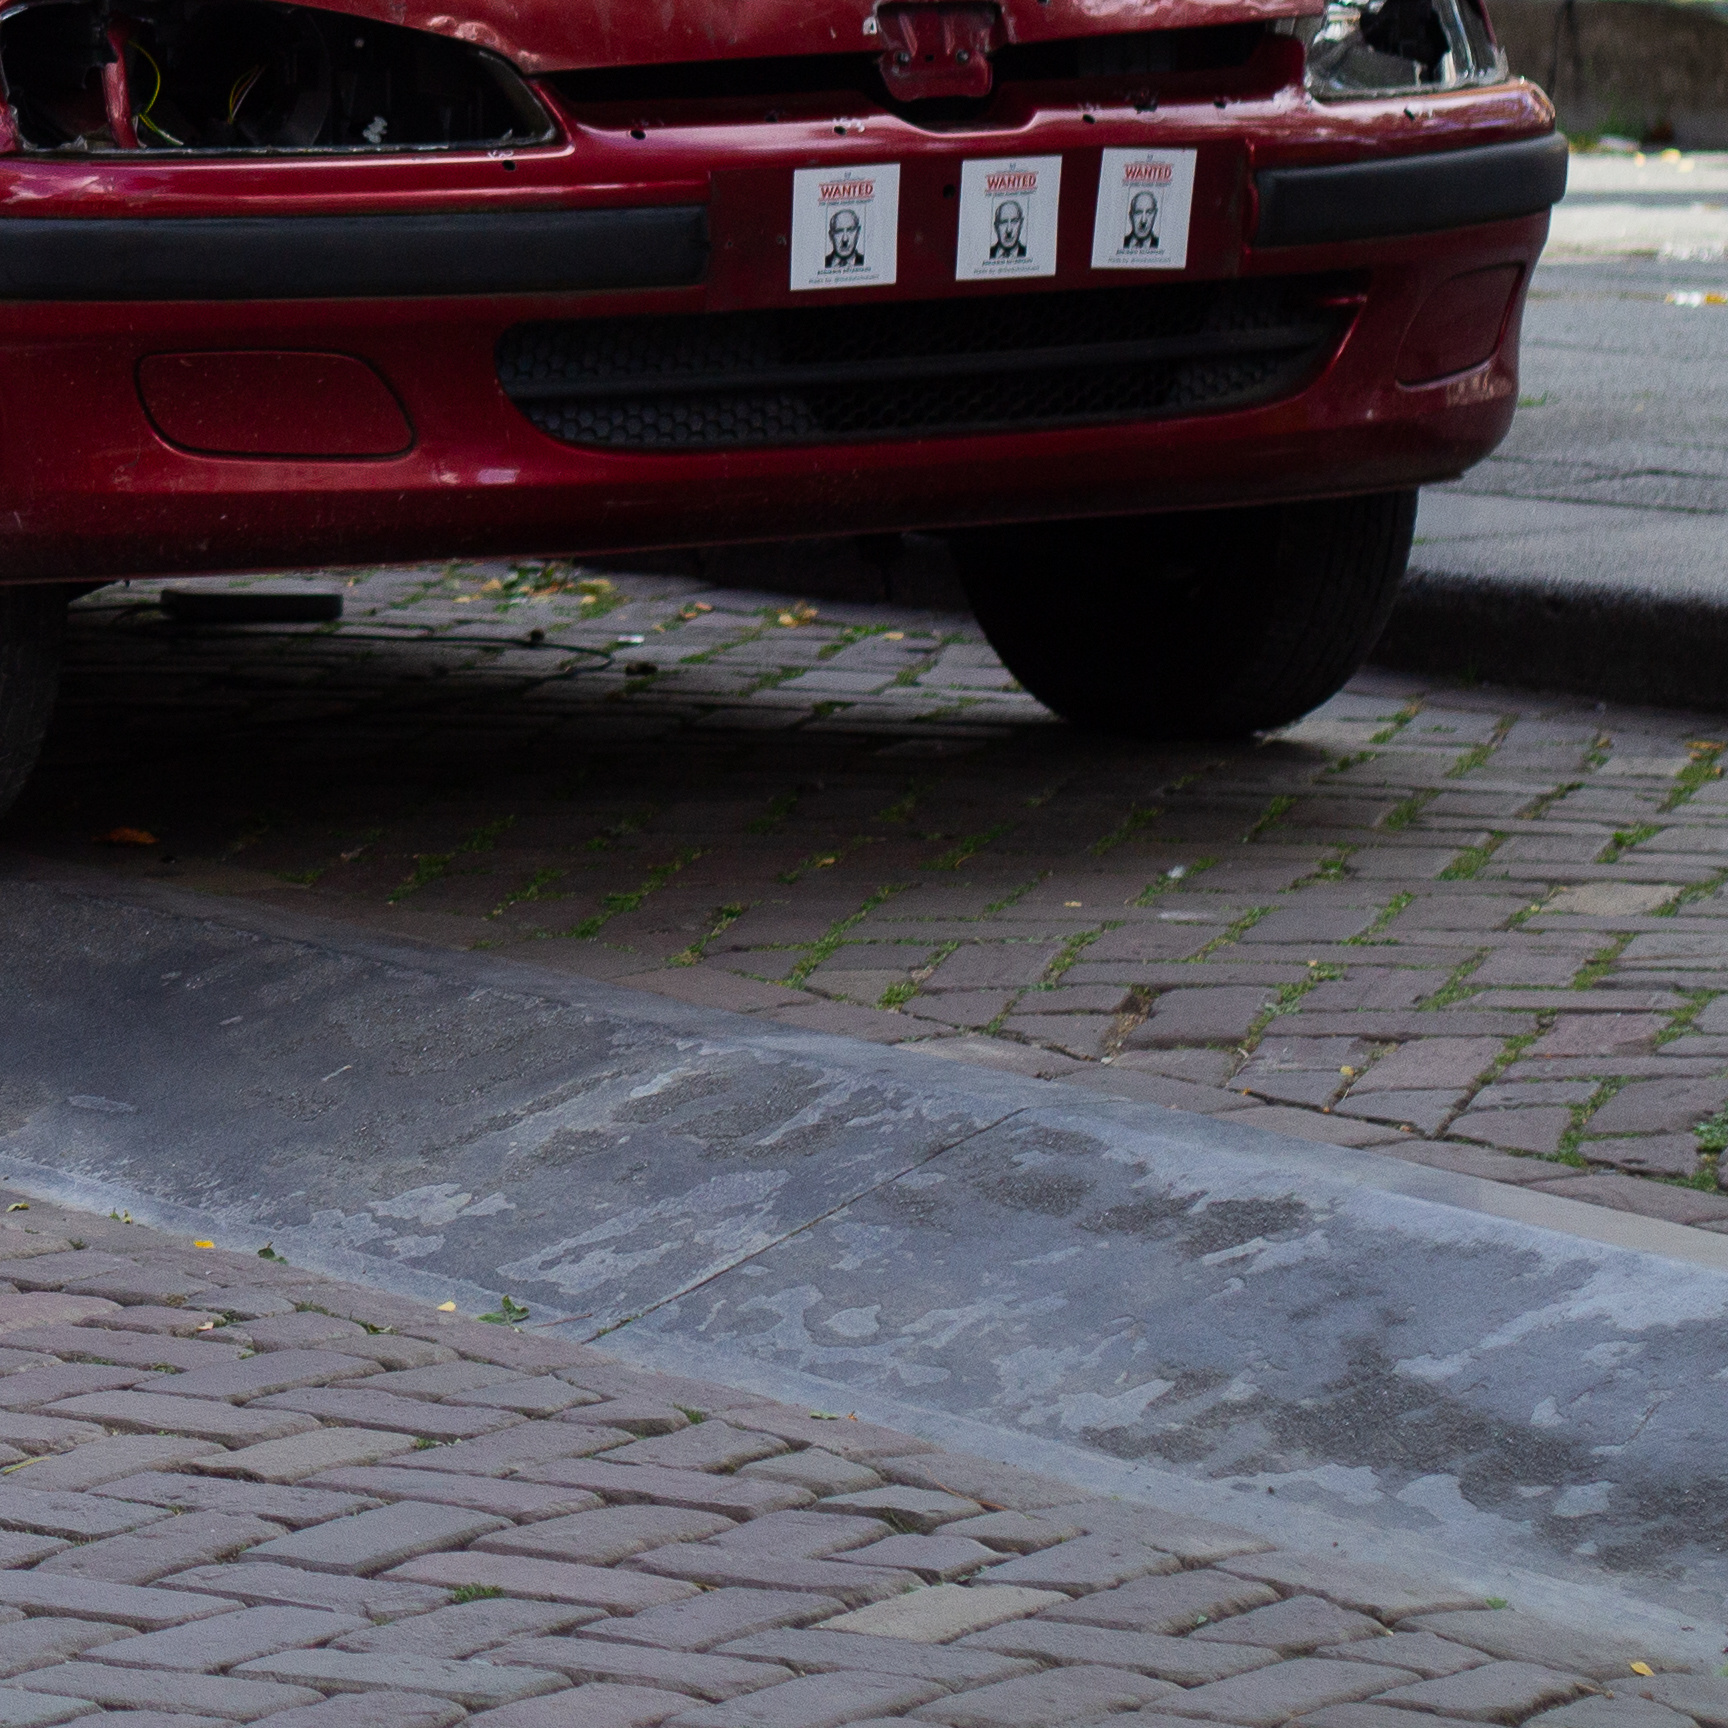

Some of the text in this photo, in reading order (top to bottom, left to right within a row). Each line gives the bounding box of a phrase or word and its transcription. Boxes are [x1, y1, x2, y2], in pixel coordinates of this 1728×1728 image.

[1125, 164, 1172, 179] WANTED
[987, 175, 1037, 189] WANTED
[820, 183, 875, 198] WANTED
